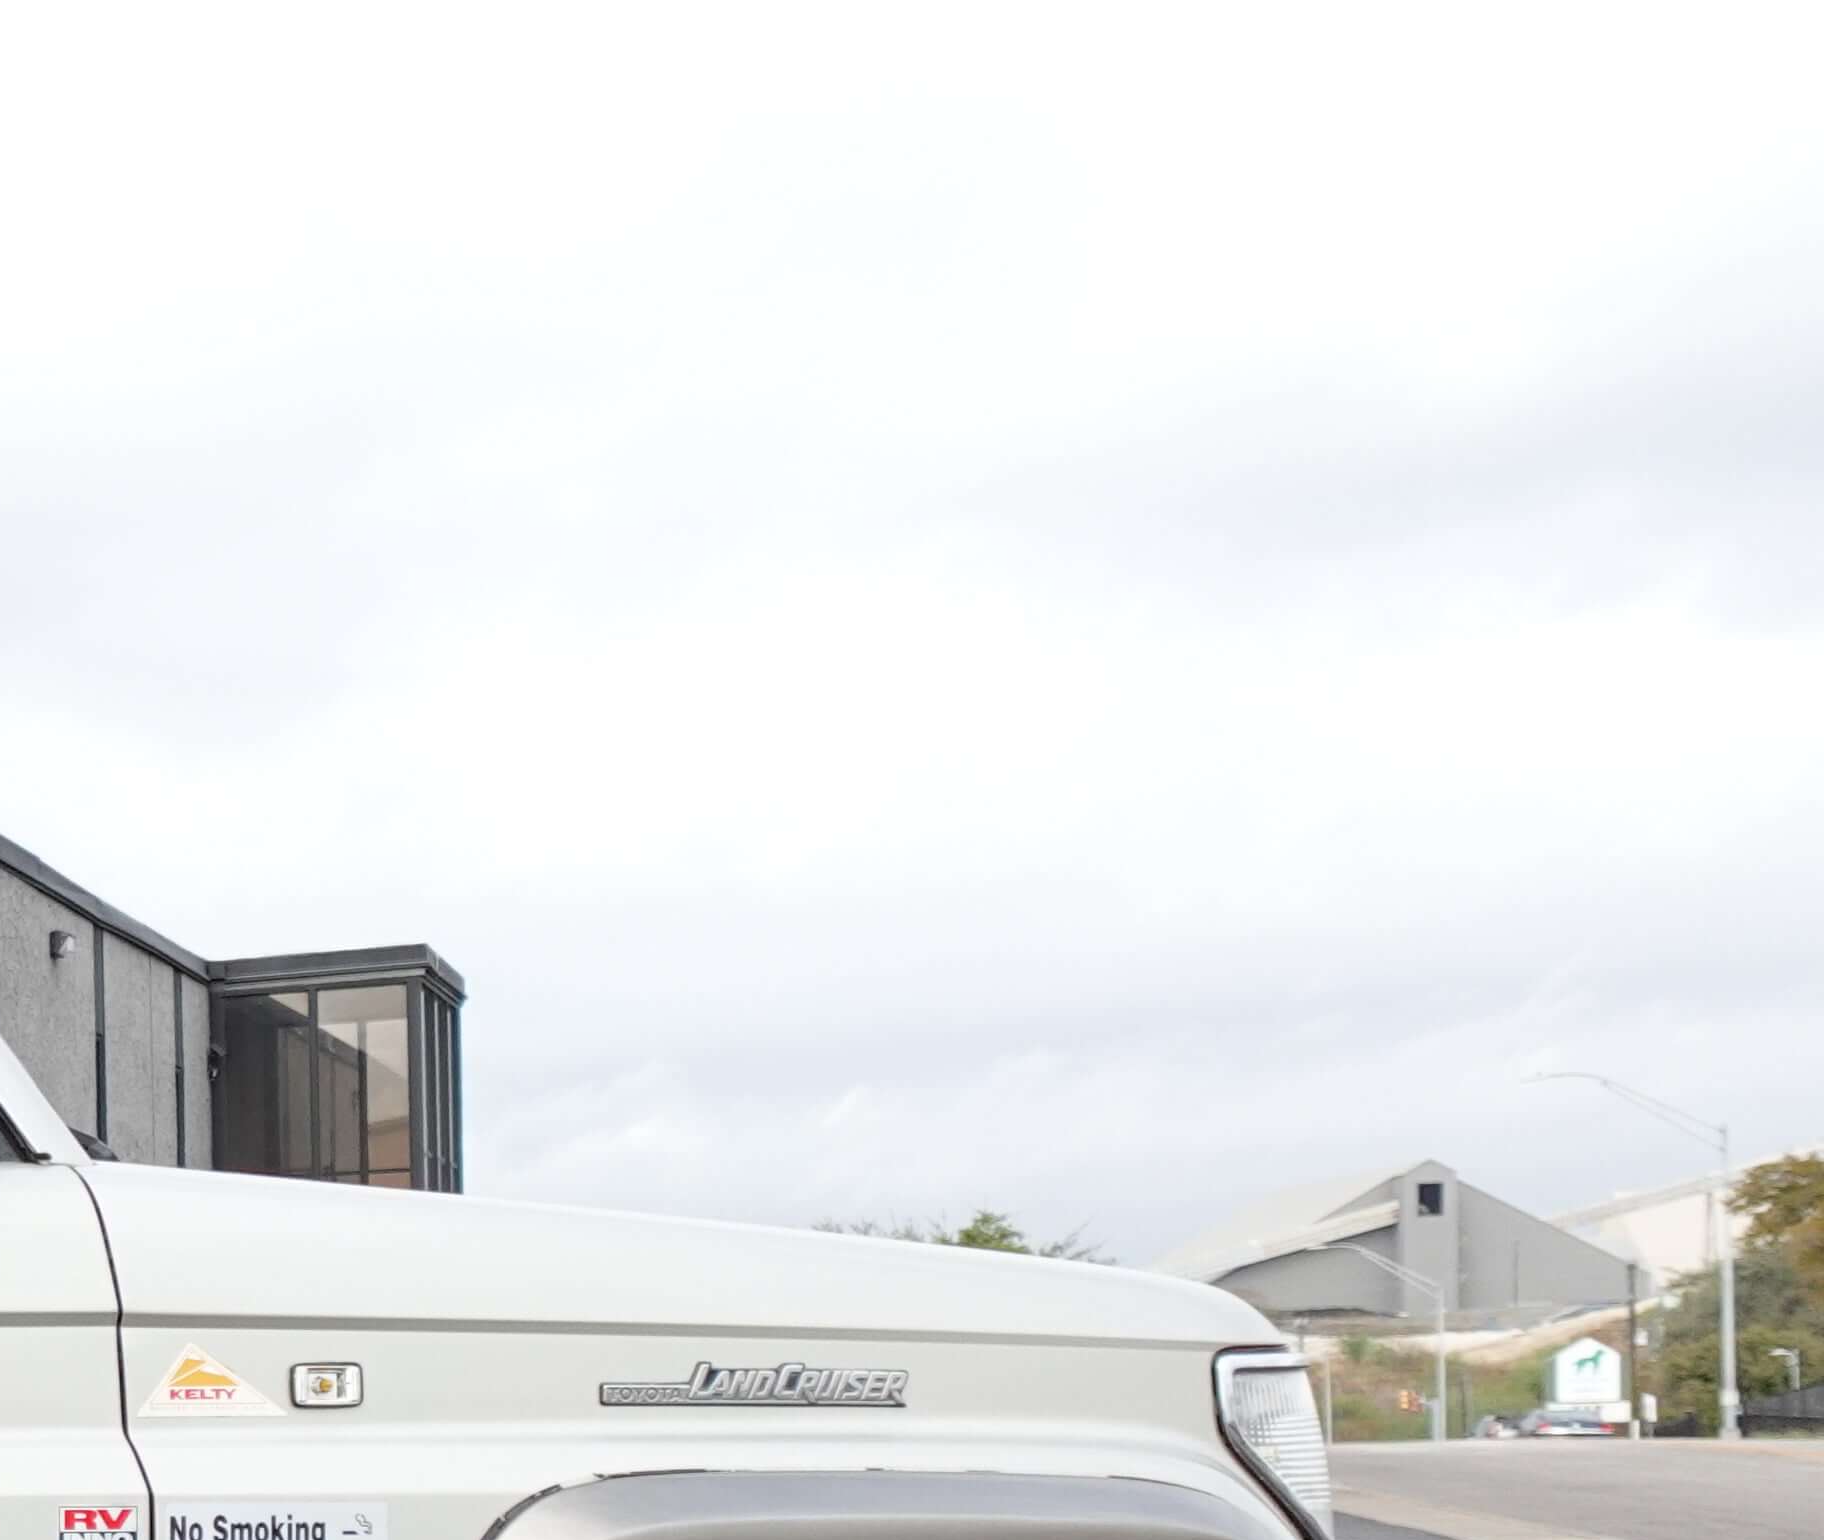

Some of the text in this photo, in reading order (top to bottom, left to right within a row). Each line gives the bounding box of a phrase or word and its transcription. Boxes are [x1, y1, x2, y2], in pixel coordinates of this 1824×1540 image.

[169, 1388, 237, 1400] KELTY
[605, 1387, 686, 1402] TOYOTA
[63, 1509, 133, 1530] RV
